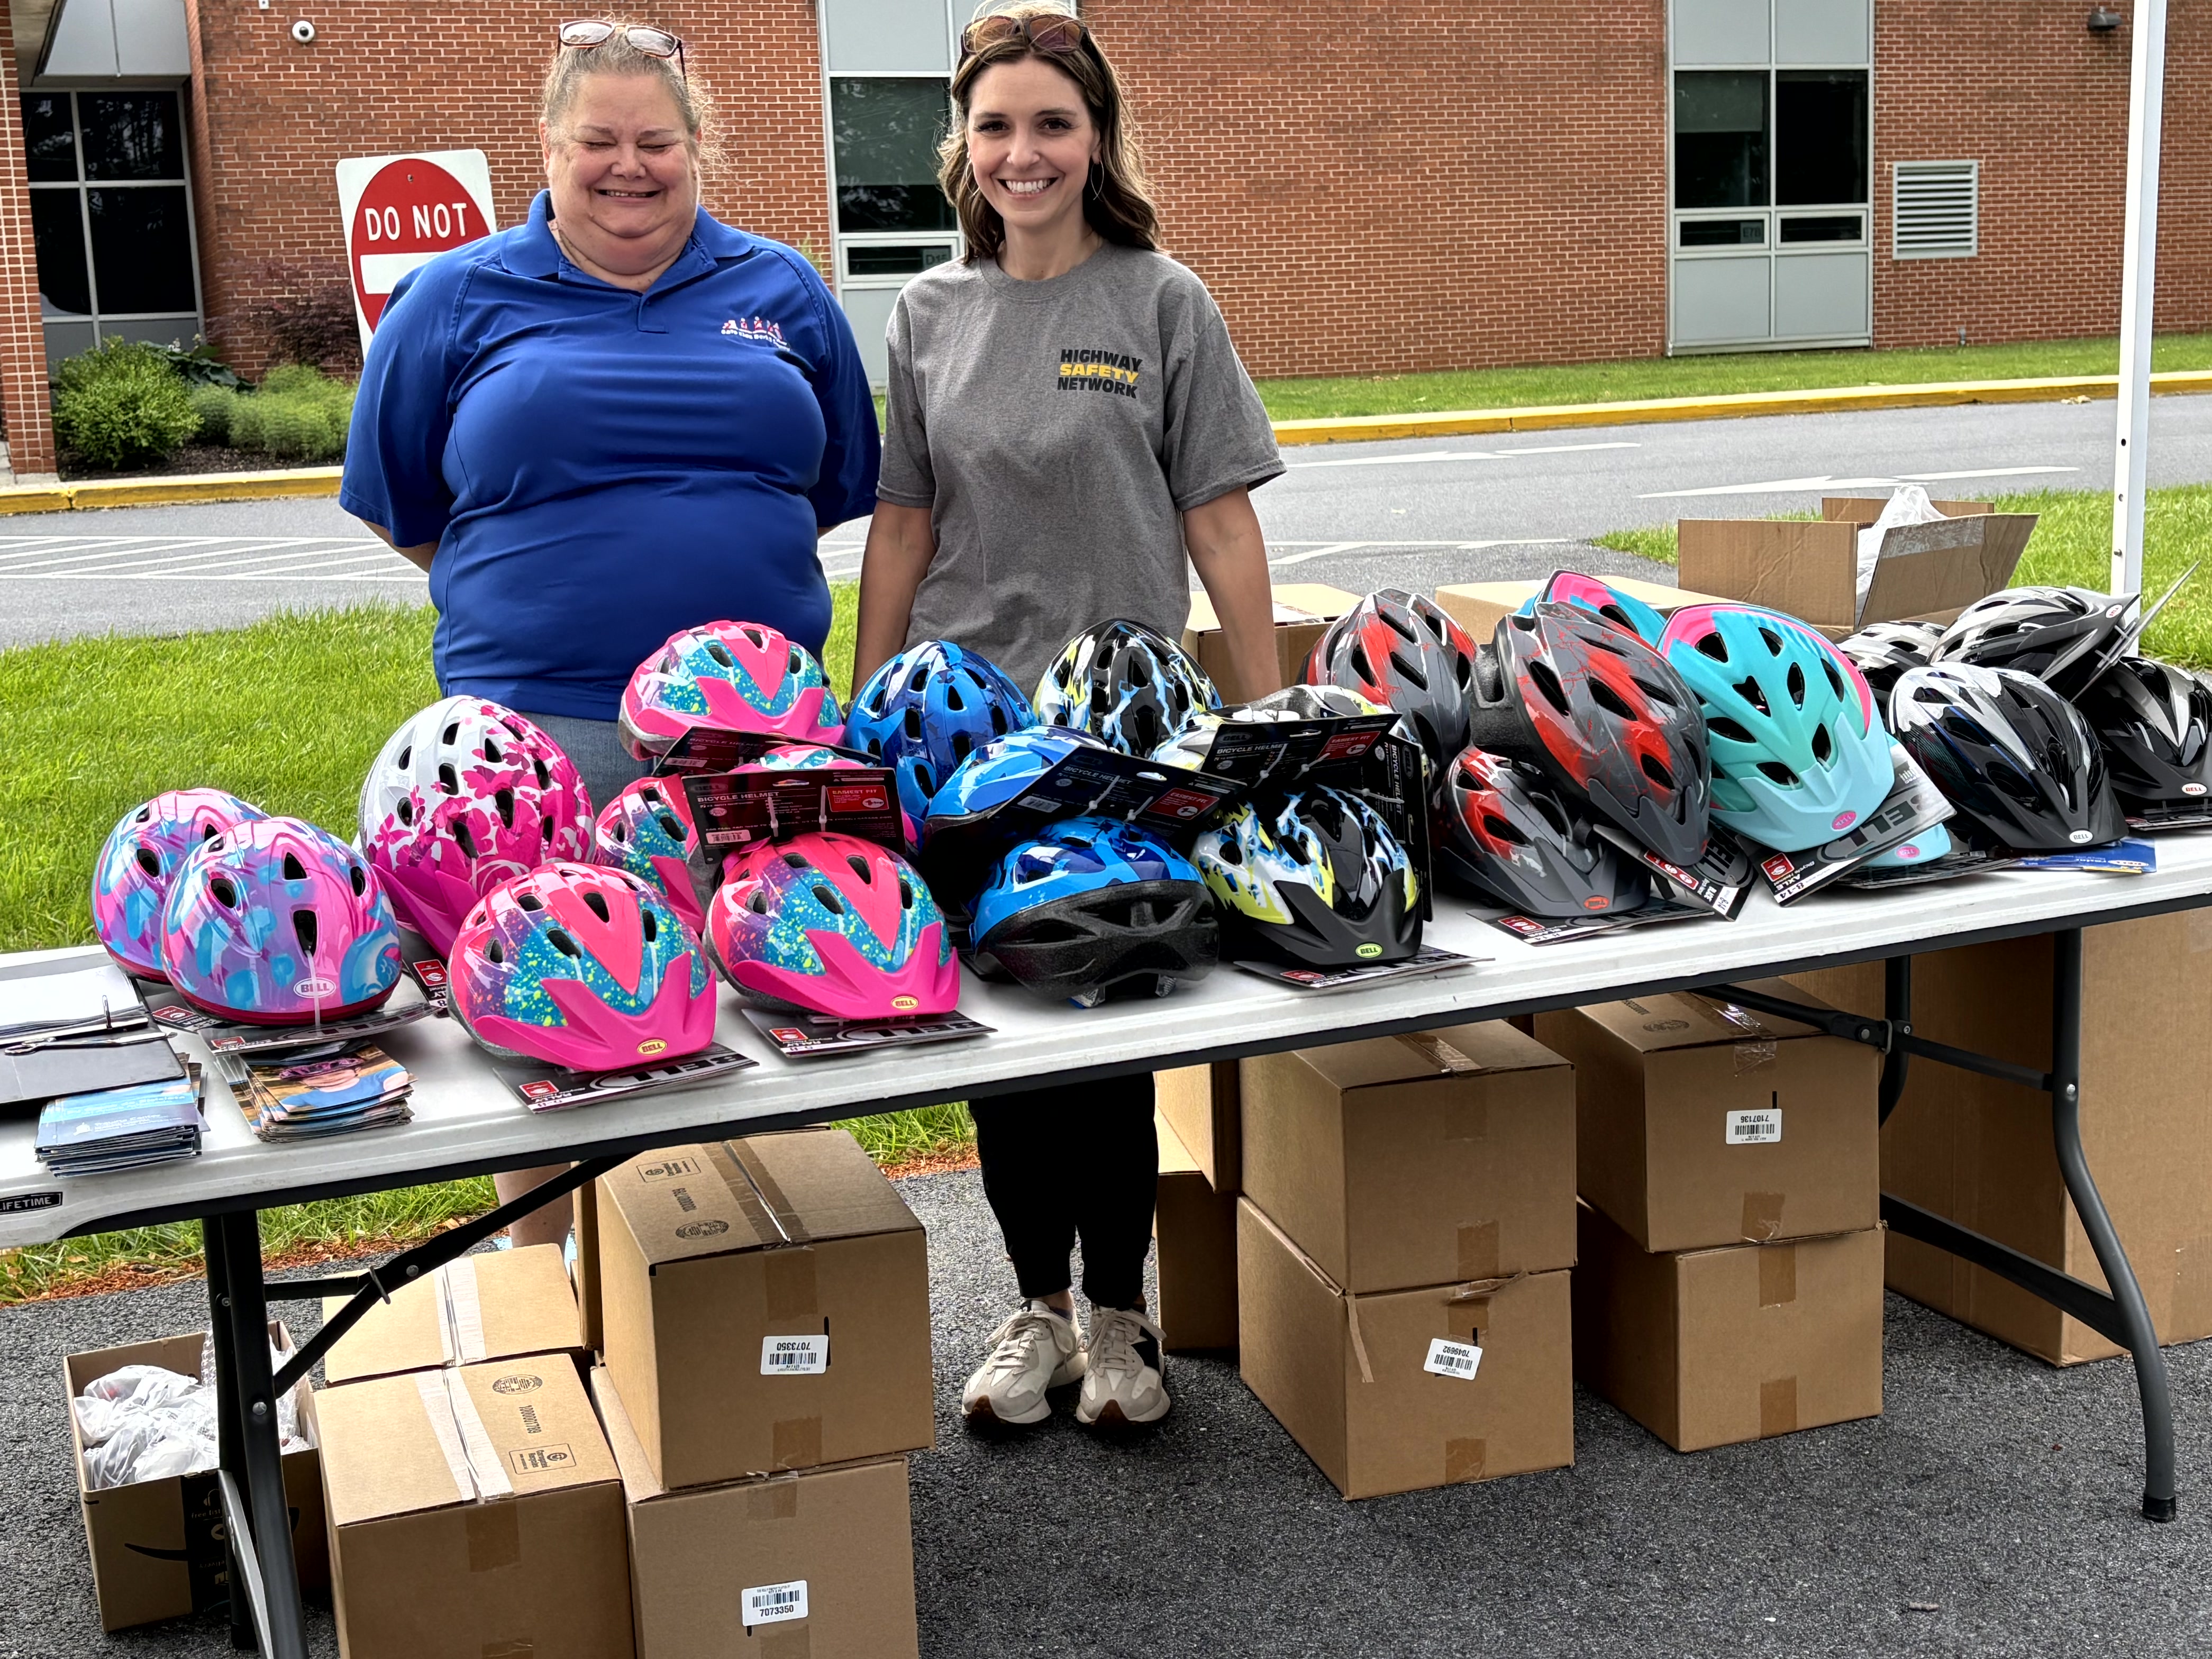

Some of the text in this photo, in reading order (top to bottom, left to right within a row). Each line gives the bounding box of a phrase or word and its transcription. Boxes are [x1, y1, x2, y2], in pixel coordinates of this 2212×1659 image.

[365, 203, 467, 241] DO NOT
[1060, 349, 1143, 372] HIGHWAY
[1060, 363, 1139, 384] SAFETY
[1058, 377, 1137, 399] NETWORK
[1063, 765, 1099, 777] BICYCLE
[1776, 873, 1801, 890] AXLE
[1780, 882, 1805, 899] 8-14
[641, 1043, 663, 1053] BELL
[1741, 1115, 1769, 1123] 7107136
[777, 1342, 811, 1351] 7073350
[1443, 1345, 1470, 1357] 7049692
[760, 1605, 794, 1617] 7073350
